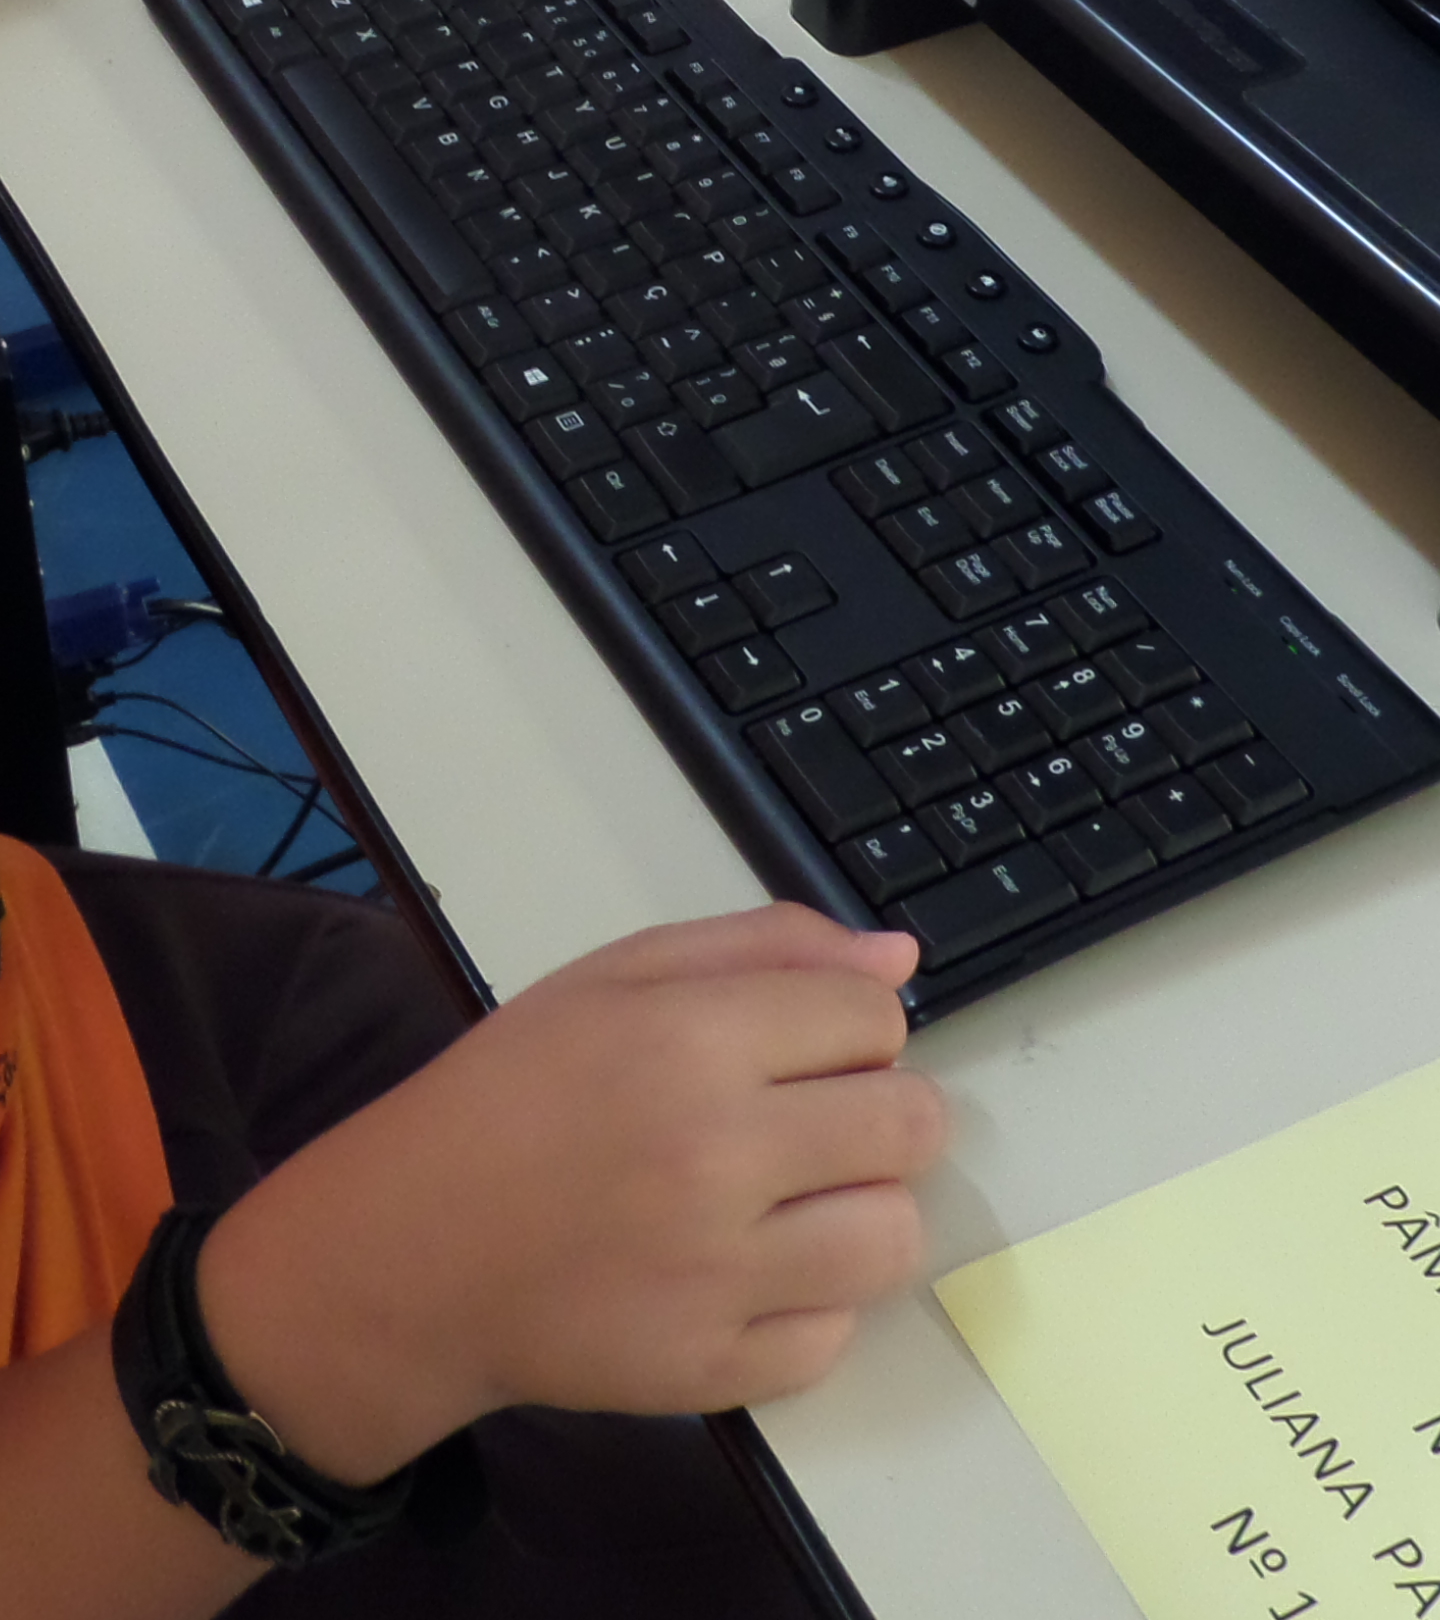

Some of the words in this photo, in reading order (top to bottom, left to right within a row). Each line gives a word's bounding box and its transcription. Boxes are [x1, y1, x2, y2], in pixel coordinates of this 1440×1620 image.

[356, 27, 378, 42] X
[458, 61, 480, 73] F
[545, 64, 565, 78] T
[412, 97, 433, 110] V
[489, 95, 510, 110] G
[575, 100, 596, 113] Y
[438, 131, 460, 146] B
[516, 130, 539, 145] H
[605, 136, 627, 151] U
[547, 170, 570, 181] J
[579, 203, 602, 220] K
[703, 250, 726, 264] P
[960, 348, 983, 370] F12
[1049, 449, 1072, 472] Lock
[874, 458, 902, 486] Delete
[986, 478, 1013, 505] Home
[916, 505, 940, 528] End
[1026, 529, 1044, 546] Up
[1039, 524, 1063, 549] Page
[954, 558, 982, 586] Down
[967, 553, 992, 579] Page
[1081, 590, 1106, 615] Lock
[1095, 585, 1118, 610] Num
[1025, 613, 1050, 627] 7
[1002, 625, 1031, 654] Home
[1298, 634, 1322, 658] Lock
[954, 647, 976, 662] 4
[878, 678, 901, 692] 1
[1072, 667, 1097, 684] 8
[854, 689, 877, 712] End
[997, 699, 1023, 717] 5
[1358, 694, 1382, 718] Lock
[799, 706, 823, 723] 0
[1121, 722, 1146, 740] 9
[920, 732, 948, 752] 2
[1047, 757, 1073, 776] 6
[969, 790, 995, 810] 3
[865, 837, 889, 860] Del
[991, 863, 1021, 895] Enter
[1202, 1319, 1374, 1520] JULIANA
[1210, 1507, 1287, 1579] Nº
